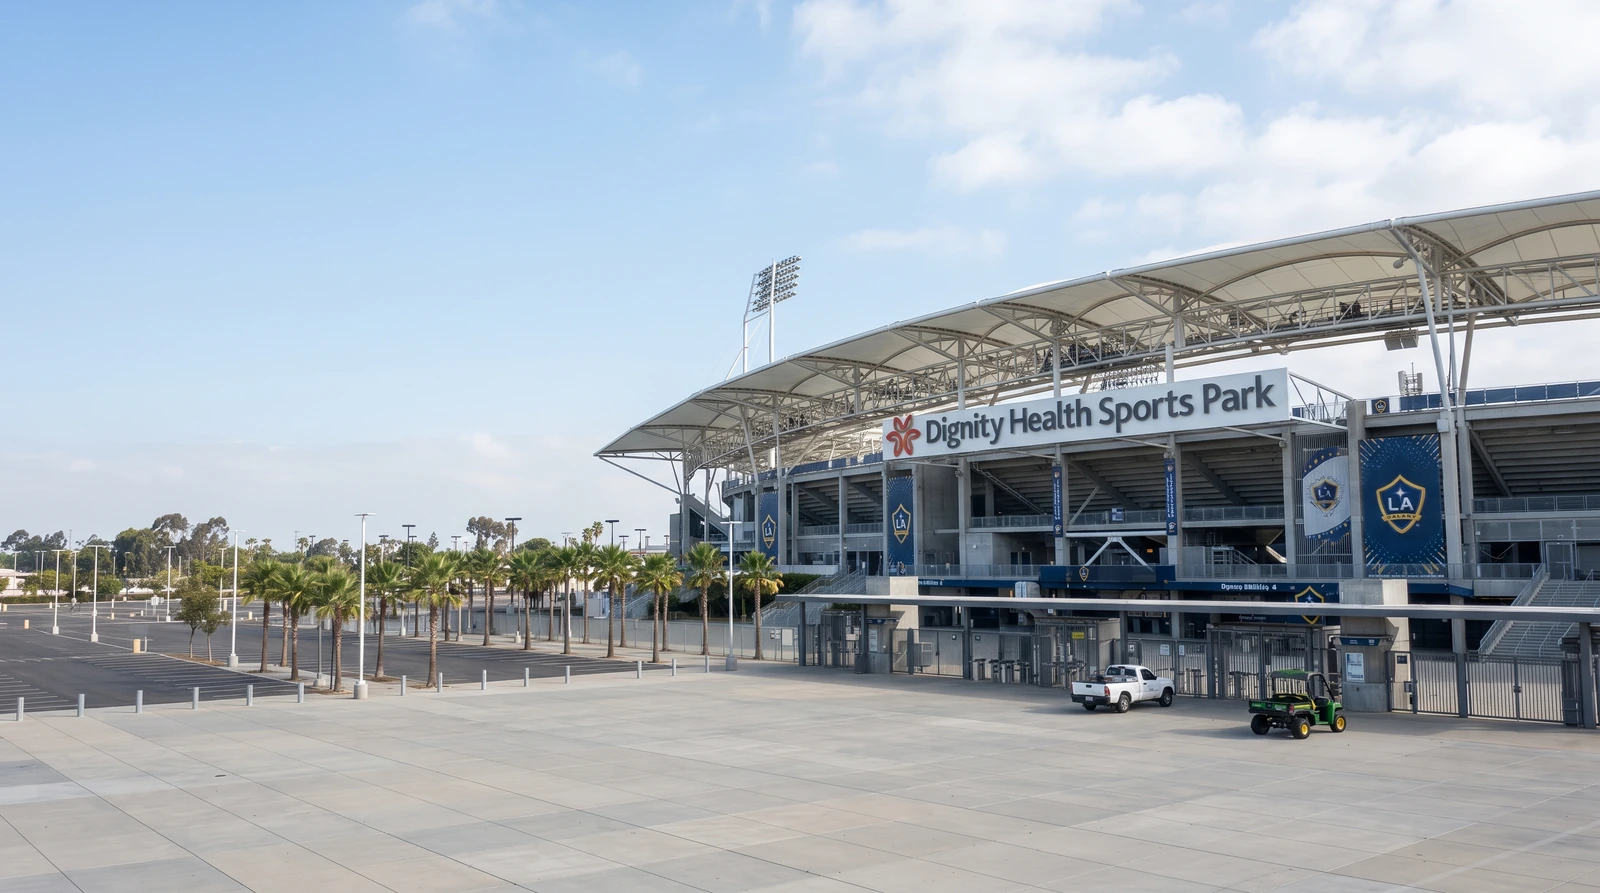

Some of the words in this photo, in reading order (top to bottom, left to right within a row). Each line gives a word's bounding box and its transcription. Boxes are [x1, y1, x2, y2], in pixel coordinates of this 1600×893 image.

[925, 412, 1005, 449] Dignity
[1009, 398, 1093, 435] Health
[1098, 390, 1195, 434] Sports
[1202, 374, 1278, 415] Park
[1387, 496, 1415, 512] LA
[895, 518, 907, 530] LA
[764, 527, 773, 537] LA
